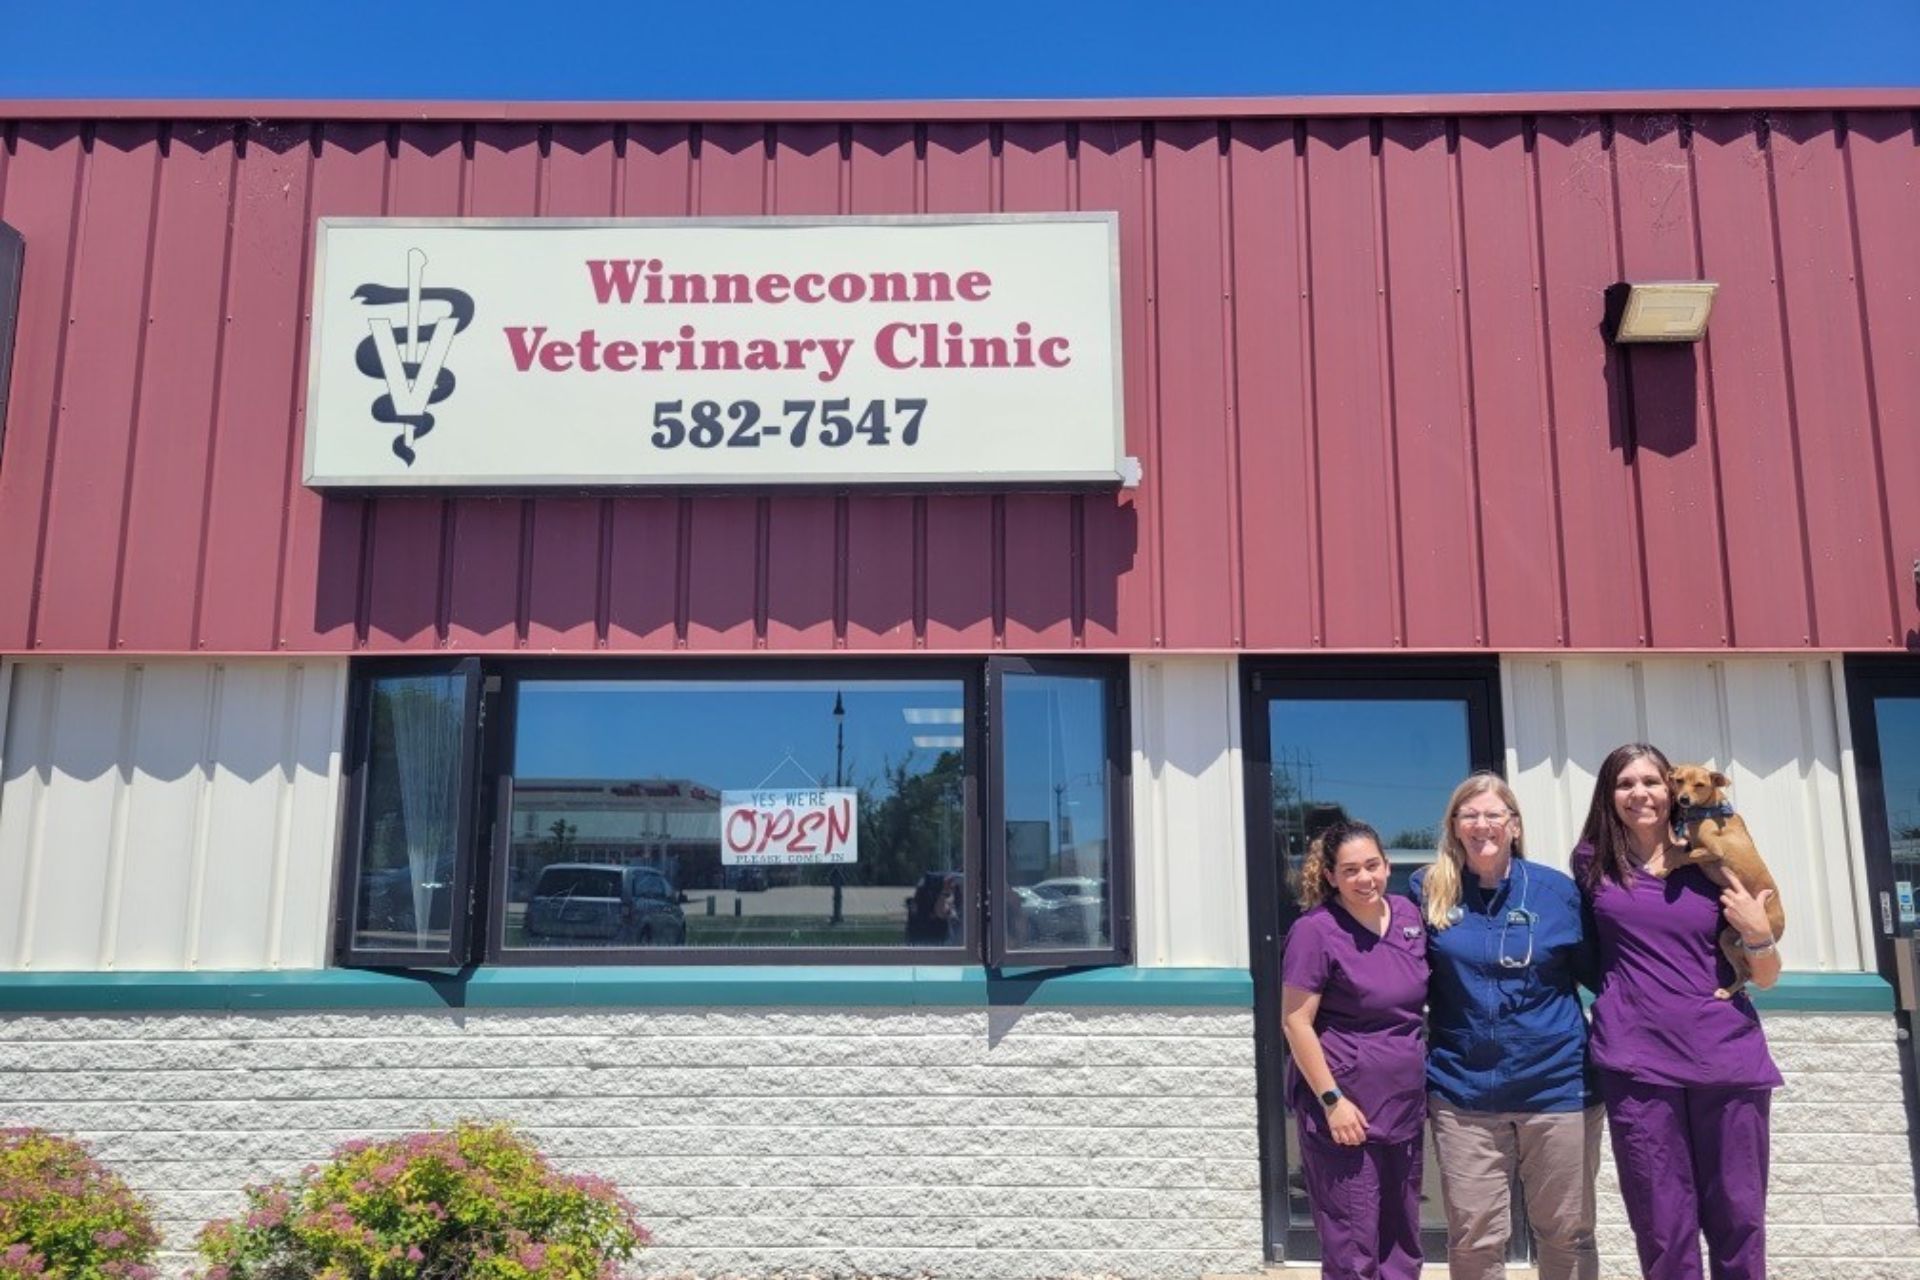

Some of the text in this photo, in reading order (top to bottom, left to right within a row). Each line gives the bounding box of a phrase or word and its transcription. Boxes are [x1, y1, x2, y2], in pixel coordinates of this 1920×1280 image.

[585, 258, 992, 304] Winneconne
[503, 321, 1071, 382] Veterinary Clinic
[650, 397, 928, 450] 582-7547
[751, 792, 826, 807] YES WE'RE
[726, 798, 850, 855] OPEN
[736, 853, 845, 864] PLEASE COME IN
